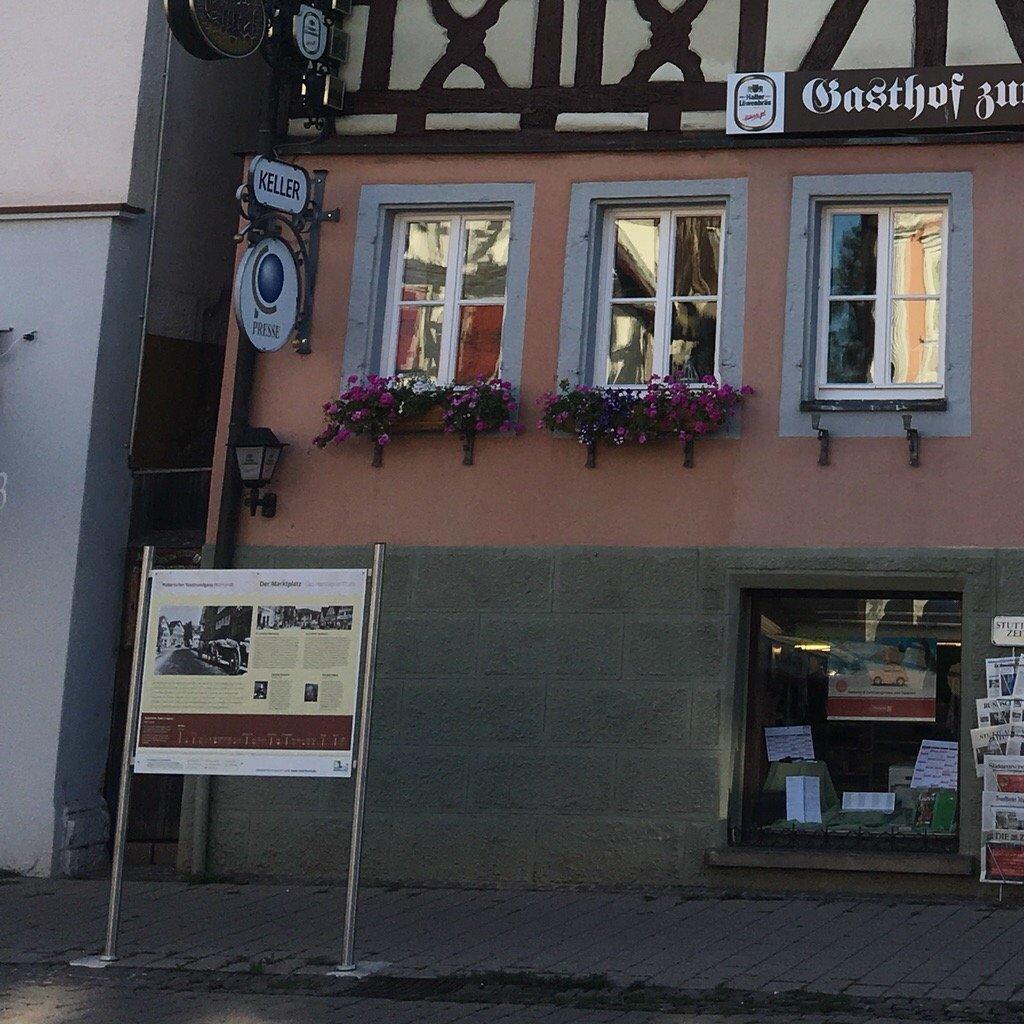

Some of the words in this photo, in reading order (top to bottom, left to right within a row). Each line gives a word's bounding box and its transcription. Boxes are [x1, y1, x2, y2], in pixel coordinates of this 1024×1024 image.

[802, 72, 965, 121] Gasthof
[258, 170, 300, 201] KELLER
[252, 321, 281, 339] PRESSE
[995, 832, 1009, 840] DIE
